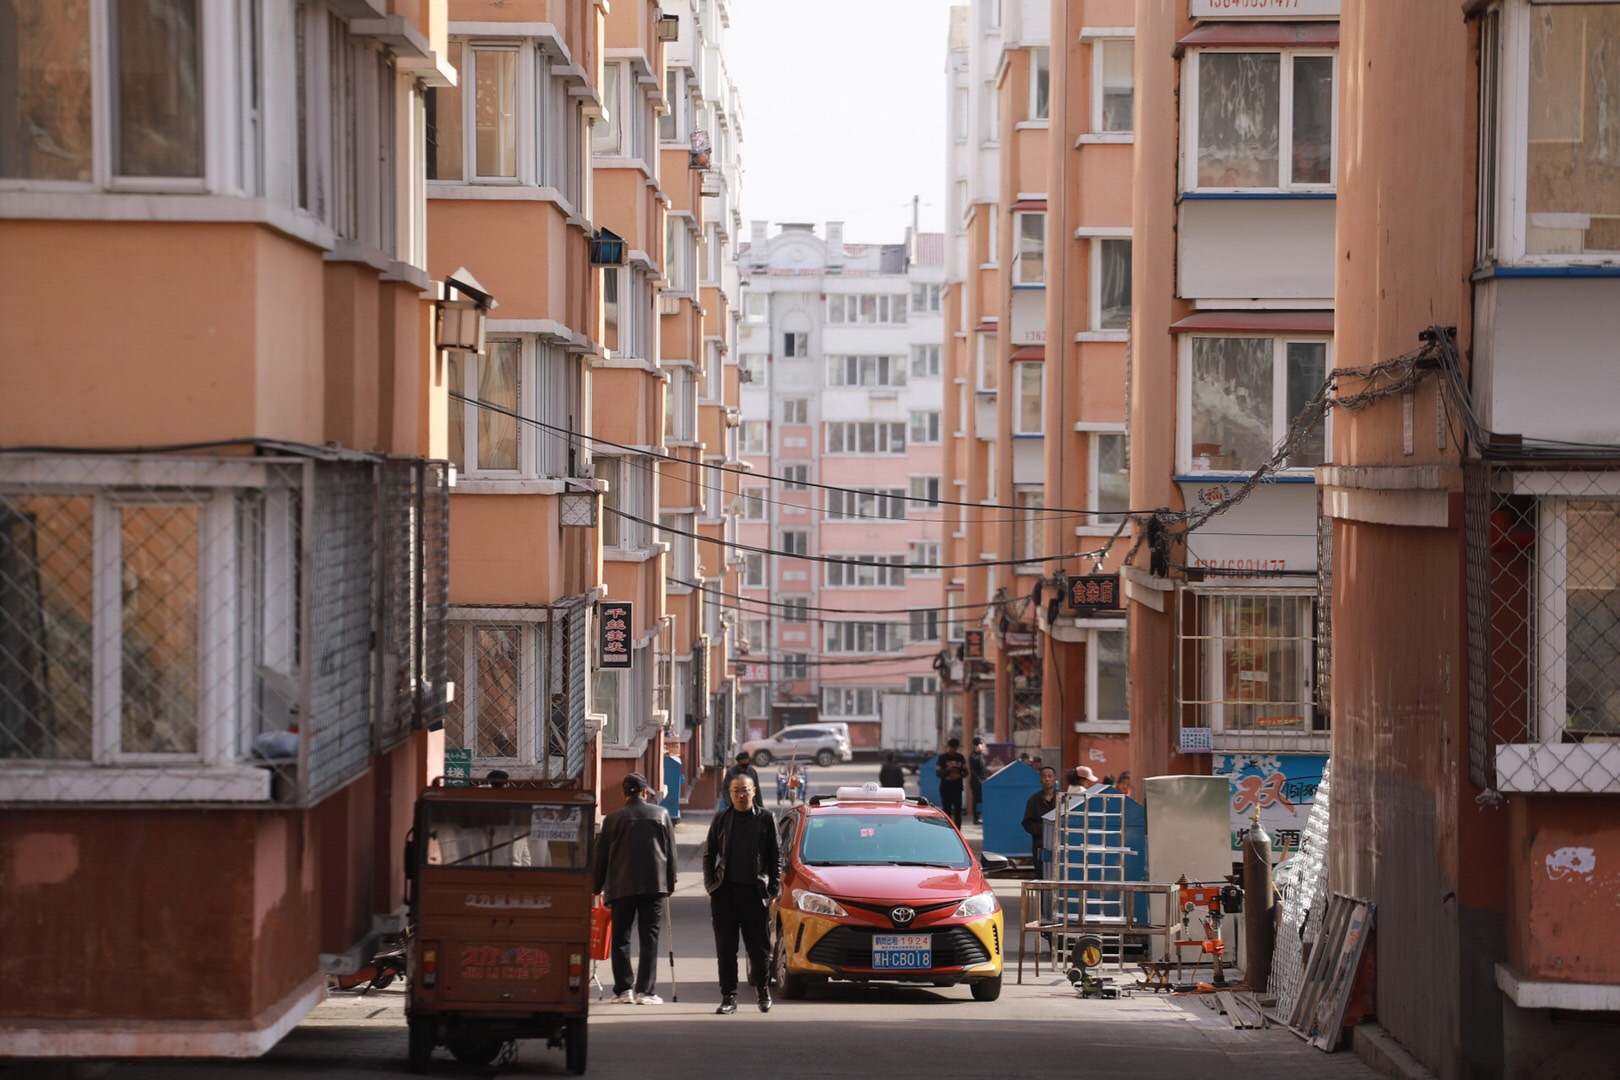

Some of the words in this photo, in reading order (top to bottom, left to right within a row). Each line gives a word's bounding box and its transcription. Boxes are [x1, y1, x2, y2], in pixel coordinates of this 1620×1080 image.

[1072, 580, 1113, 603] 食杂店
[1274, 828, 1301, 846] 酒
